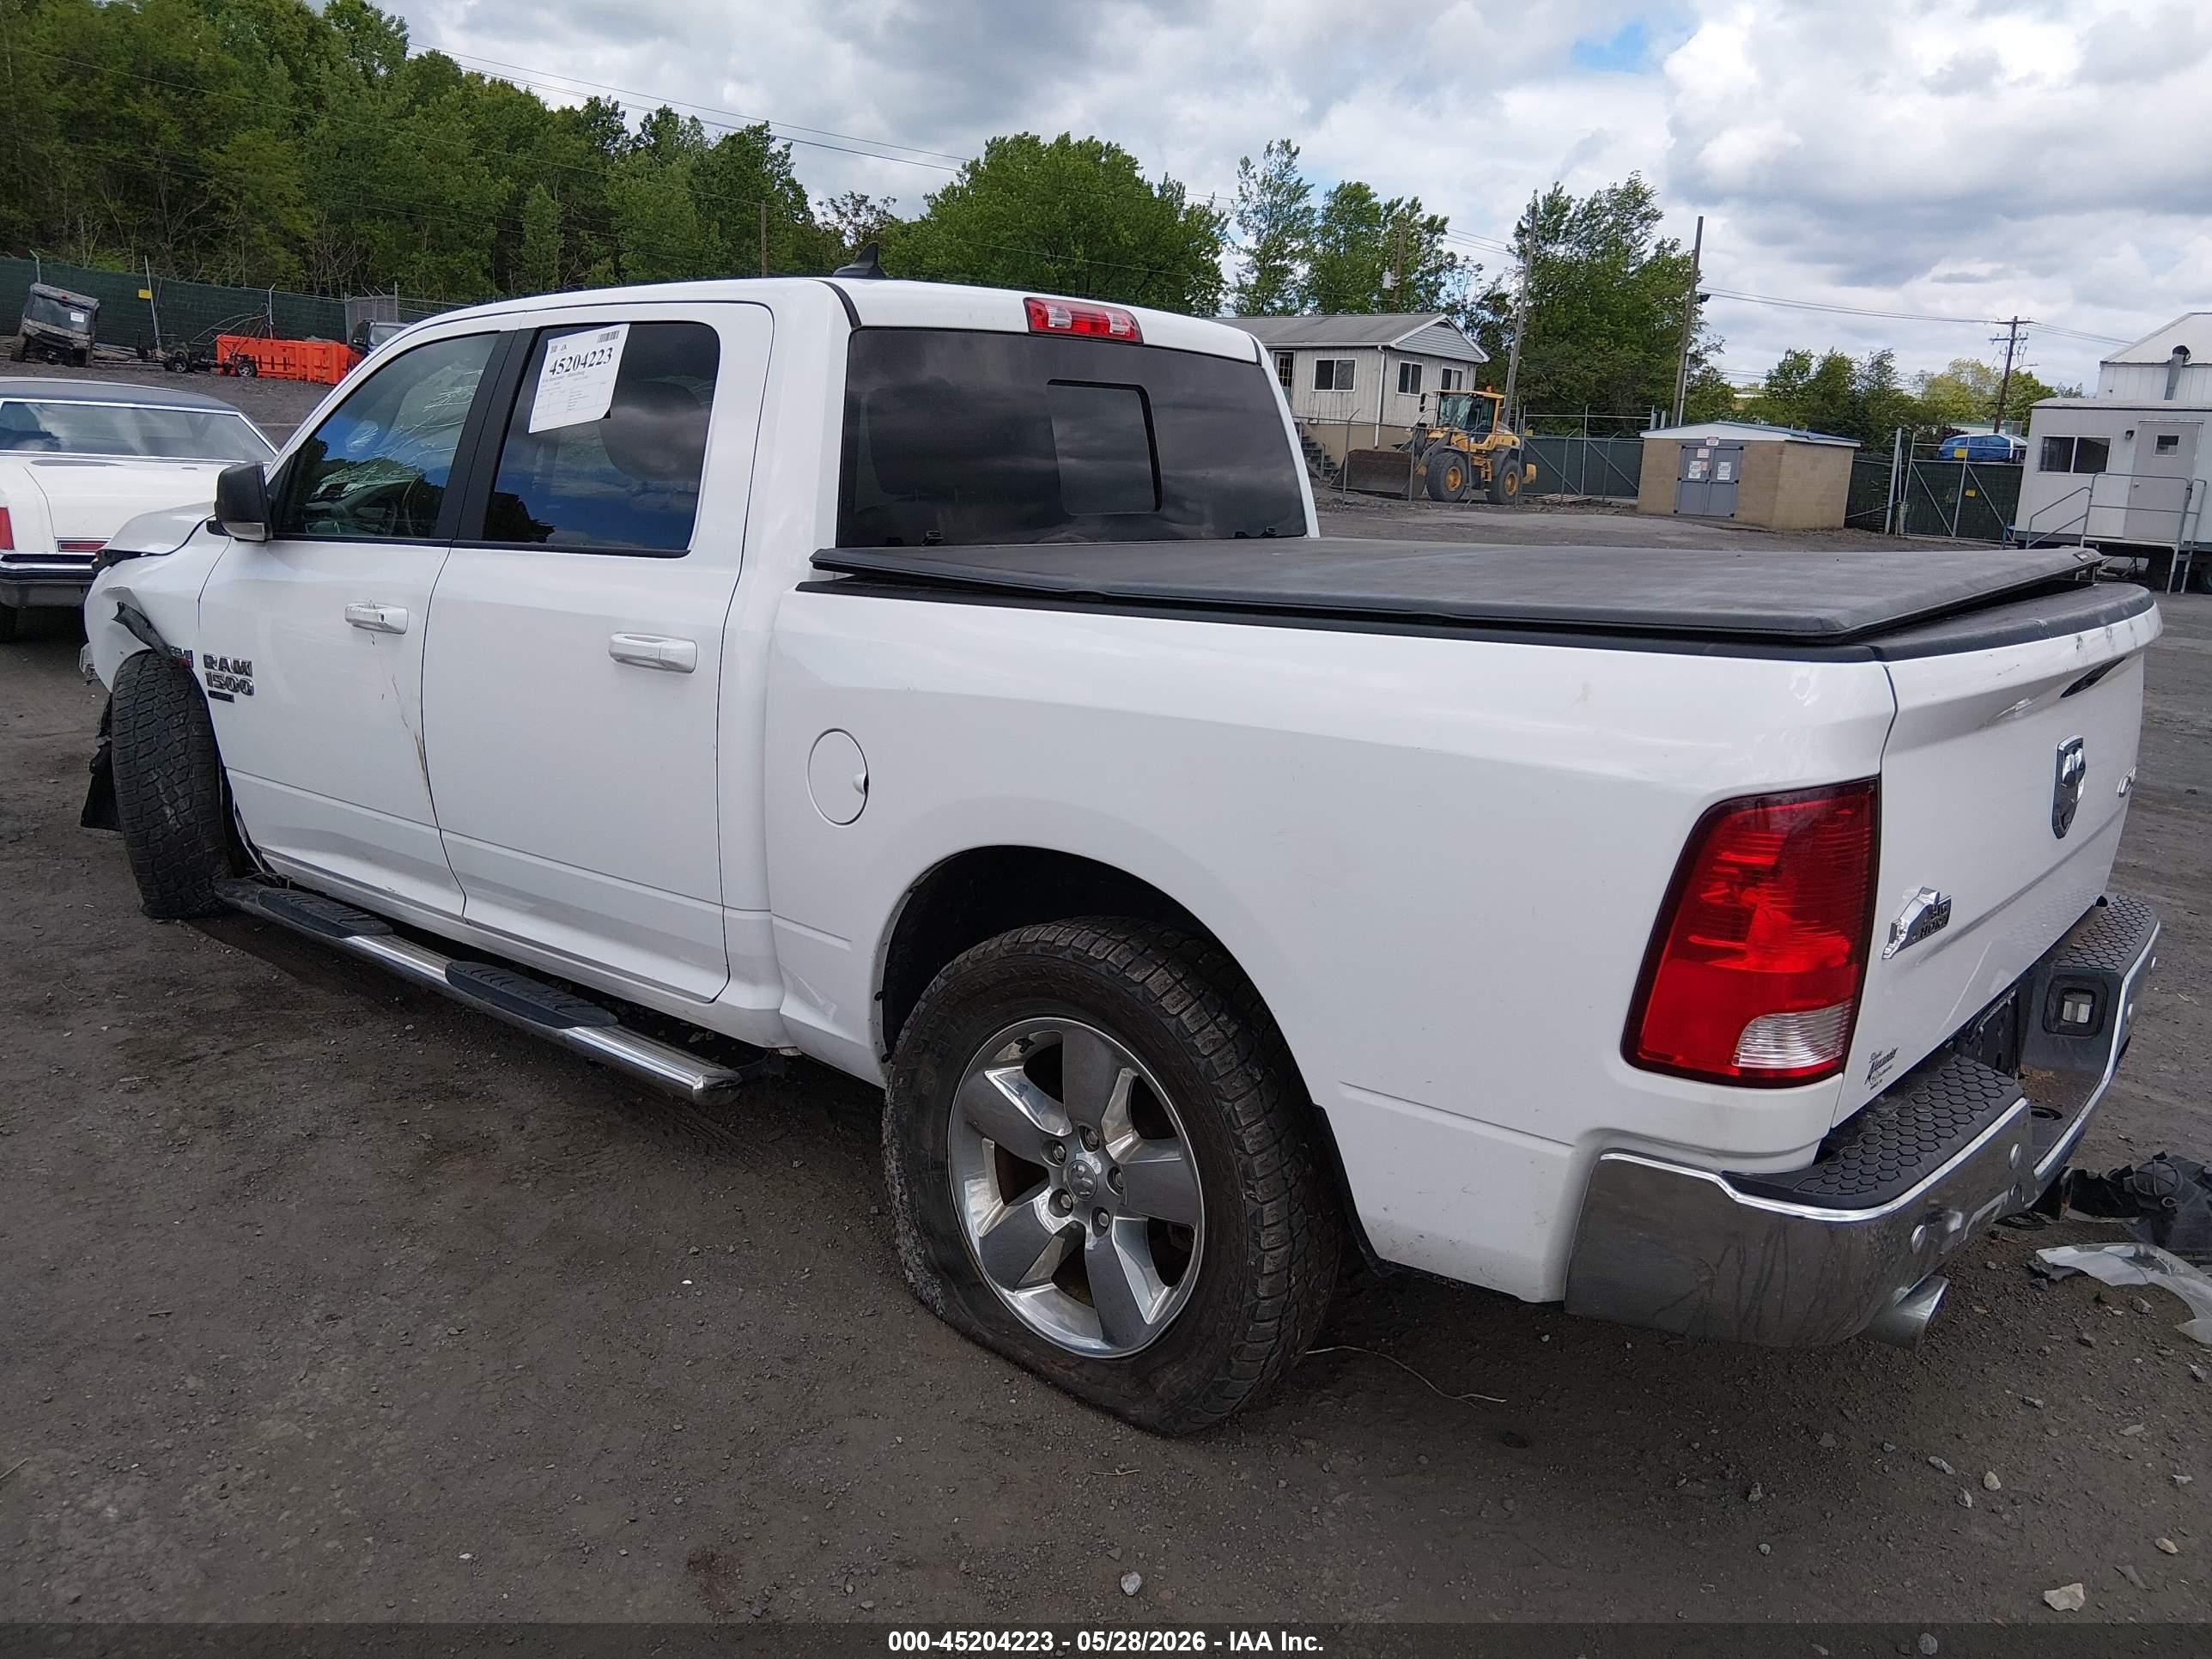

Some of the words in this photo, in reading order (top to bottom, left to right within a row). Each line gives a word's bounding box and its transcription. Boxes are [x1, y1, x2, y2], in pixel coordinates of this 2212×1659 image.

[550, 347, 613, 376] 45204223
[203, 653, 252, 678] RAM
[205, 671, 255, 696] 1500
